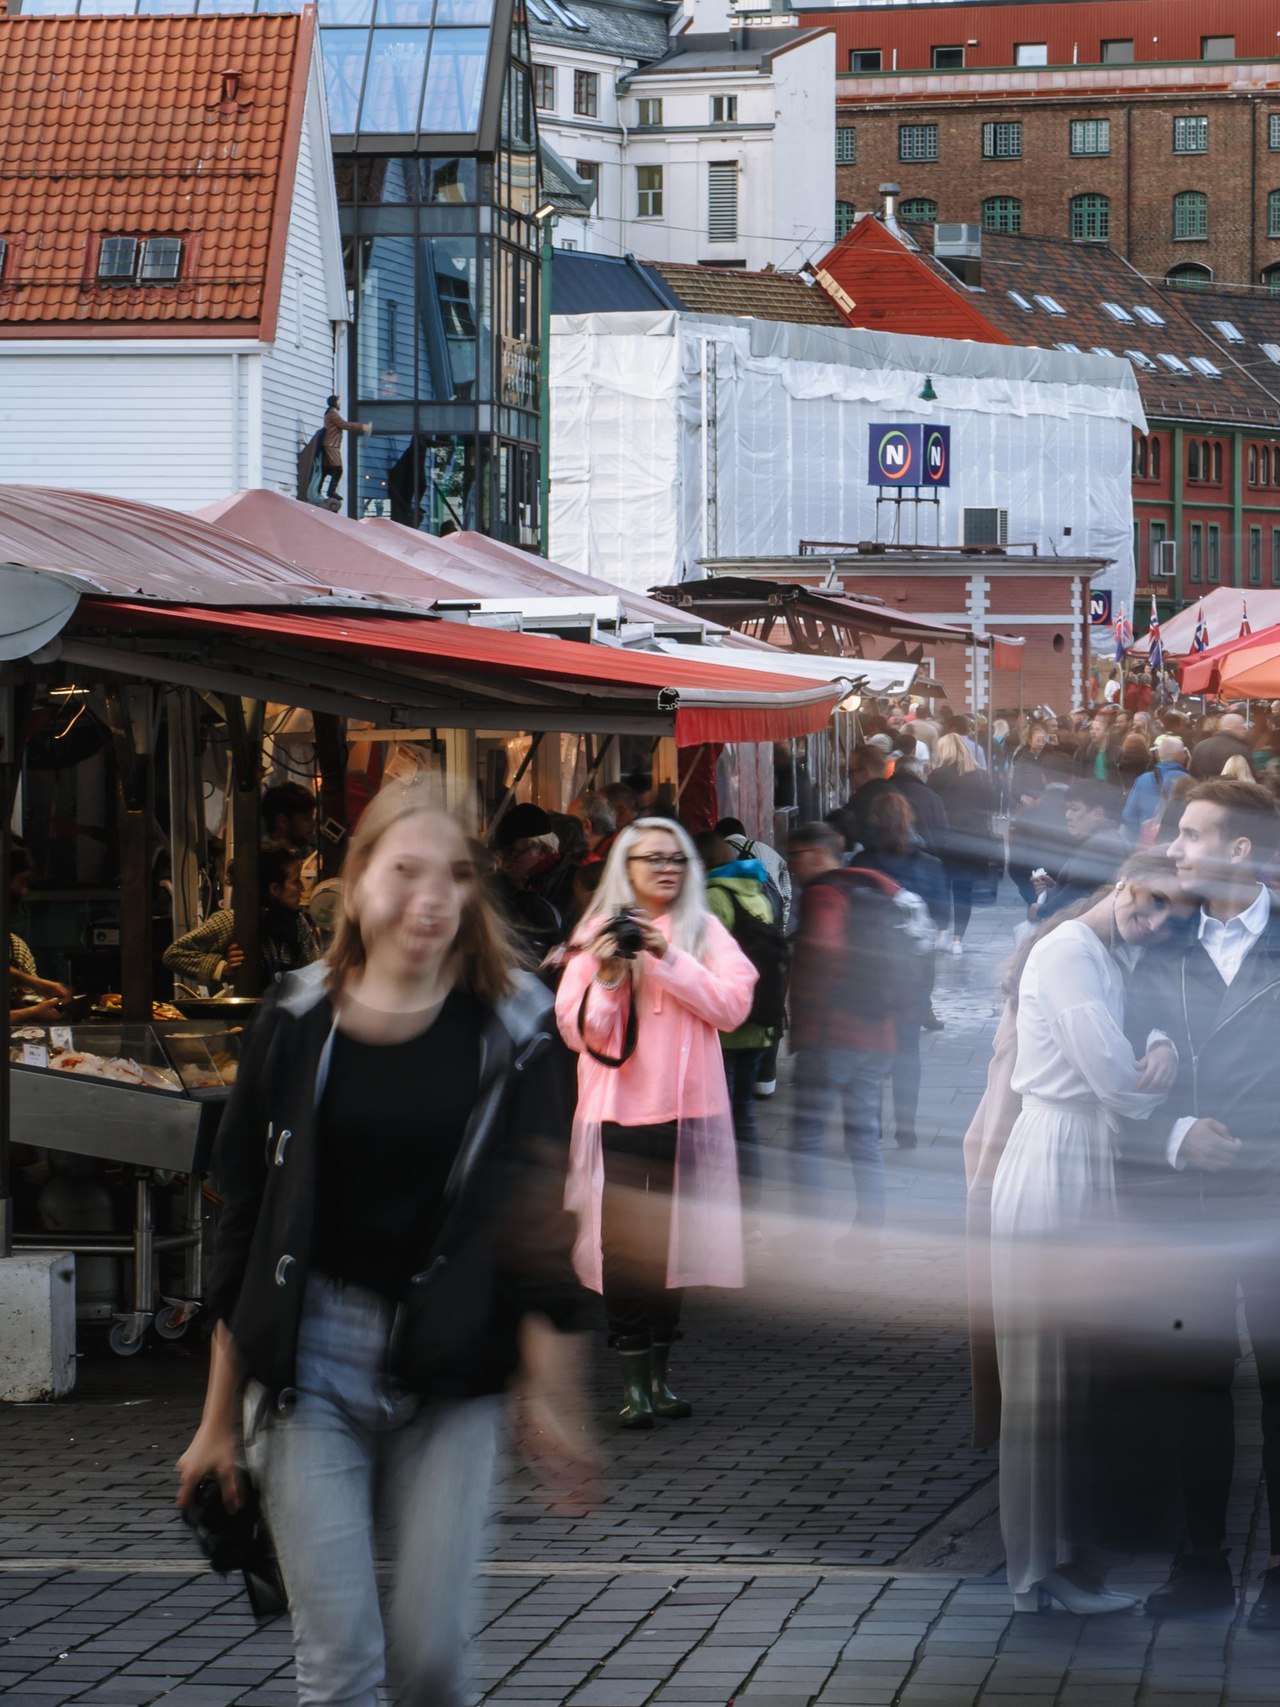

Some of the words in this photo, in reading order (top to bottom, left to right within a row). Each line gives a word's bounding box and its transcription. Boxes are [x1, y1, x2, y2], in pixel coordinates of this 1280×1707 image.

[886, 445, 903, 465] N
[930, 446, 941, 466] N
[1091, 600, 1103, 614] N
